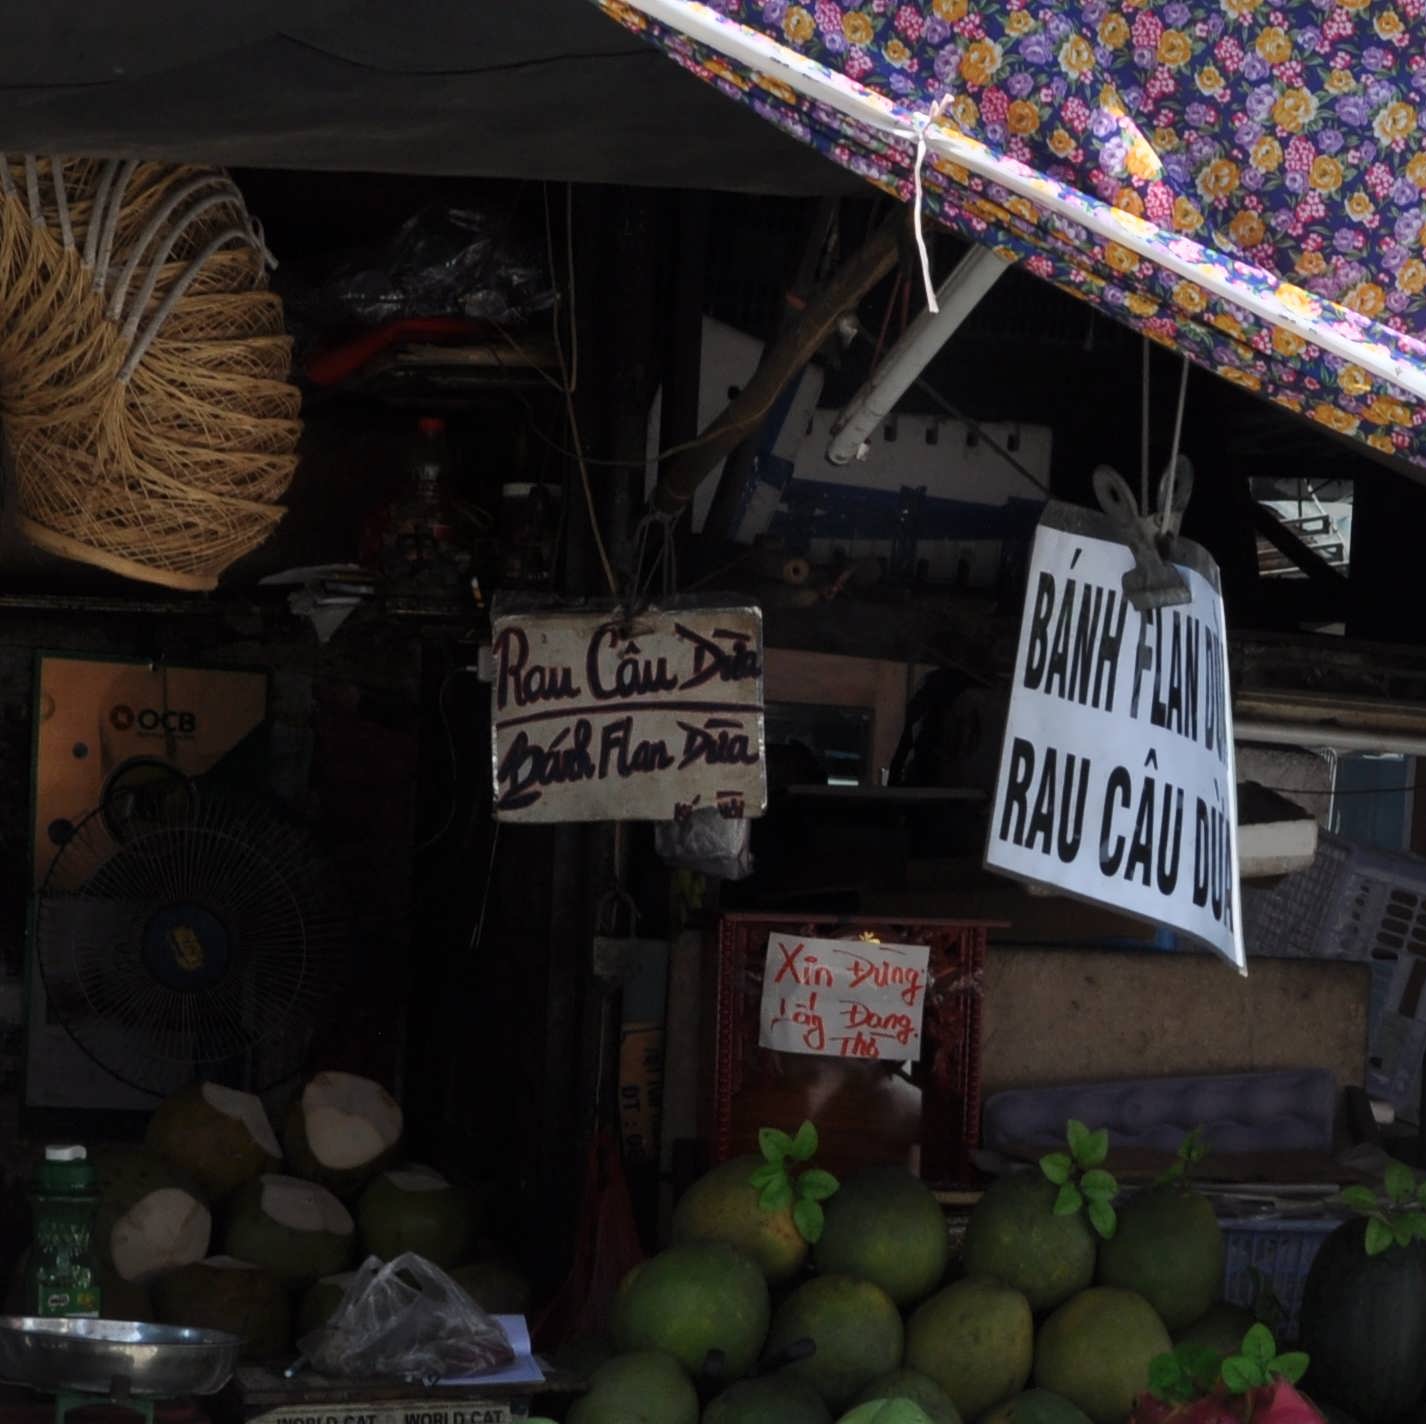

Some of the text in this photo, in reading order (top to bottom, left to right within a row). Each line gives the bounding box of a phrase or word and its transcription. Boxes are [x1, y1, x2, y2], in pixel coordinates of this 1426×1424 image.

[493, 626, 581, 711] Rau
[1024, 548, 1128, 713] BÁNH
[1130, 606, 1199, 741] FLAN
[138, 708, 196, 732] OCB
[1000, 737, 1090, 863] RAU
[1100, 748, 1184, 895] CÂU
[774, 942, 833, 988] Xin
[469, 1410, 503, 1424] CAT
